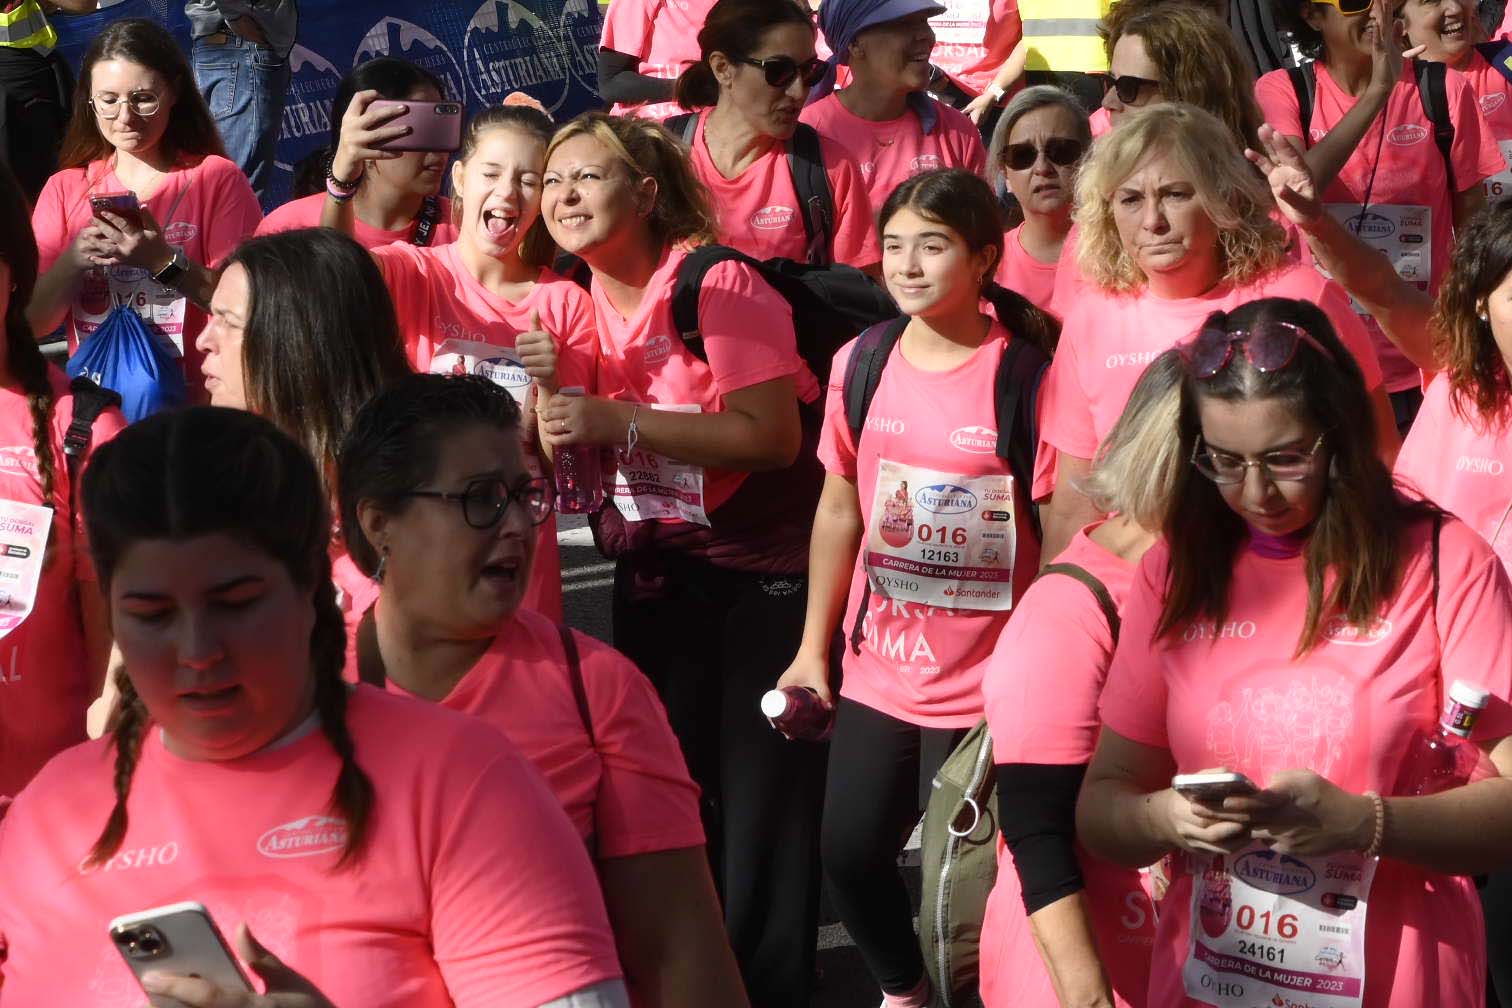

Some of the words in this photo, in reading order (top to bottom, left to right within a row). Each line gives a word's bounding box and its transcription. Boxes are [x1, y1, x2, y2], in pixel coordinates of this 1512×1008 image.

[480, 365, 529, 383] ASTURIANA
[954, 433, 997, 448] ASTURIAN
[920, 493, 972, 509] ASTURIANA
[983, 492, 1012, 502] SUMA
[917, 523, 968, 545] 016
[920, 548, 959, 563] 12163
[882, 557, 921, 573] CARRERA
[922, 565, 934, 576] DE
[935, 566, 947, 577] LA
[948, 568, 978, 579] MUJER
[875, 575, 920, 593] OYSHO
[955, 587, 1001, 600] Santander
[1240, 860, 1309, 888] ASTURIANA
[1235, 904, 1299, 939] 016
[1237, 939, 1286, 964] 24161
[1200, 973, 1245, 999] OHO
[1244, 965, 1257, 976] DE
[1258, 967, 1273, 979] LA
[1273, 970, 1313, 988] MUJER
[1316, 979, 1344, 991] 2023
